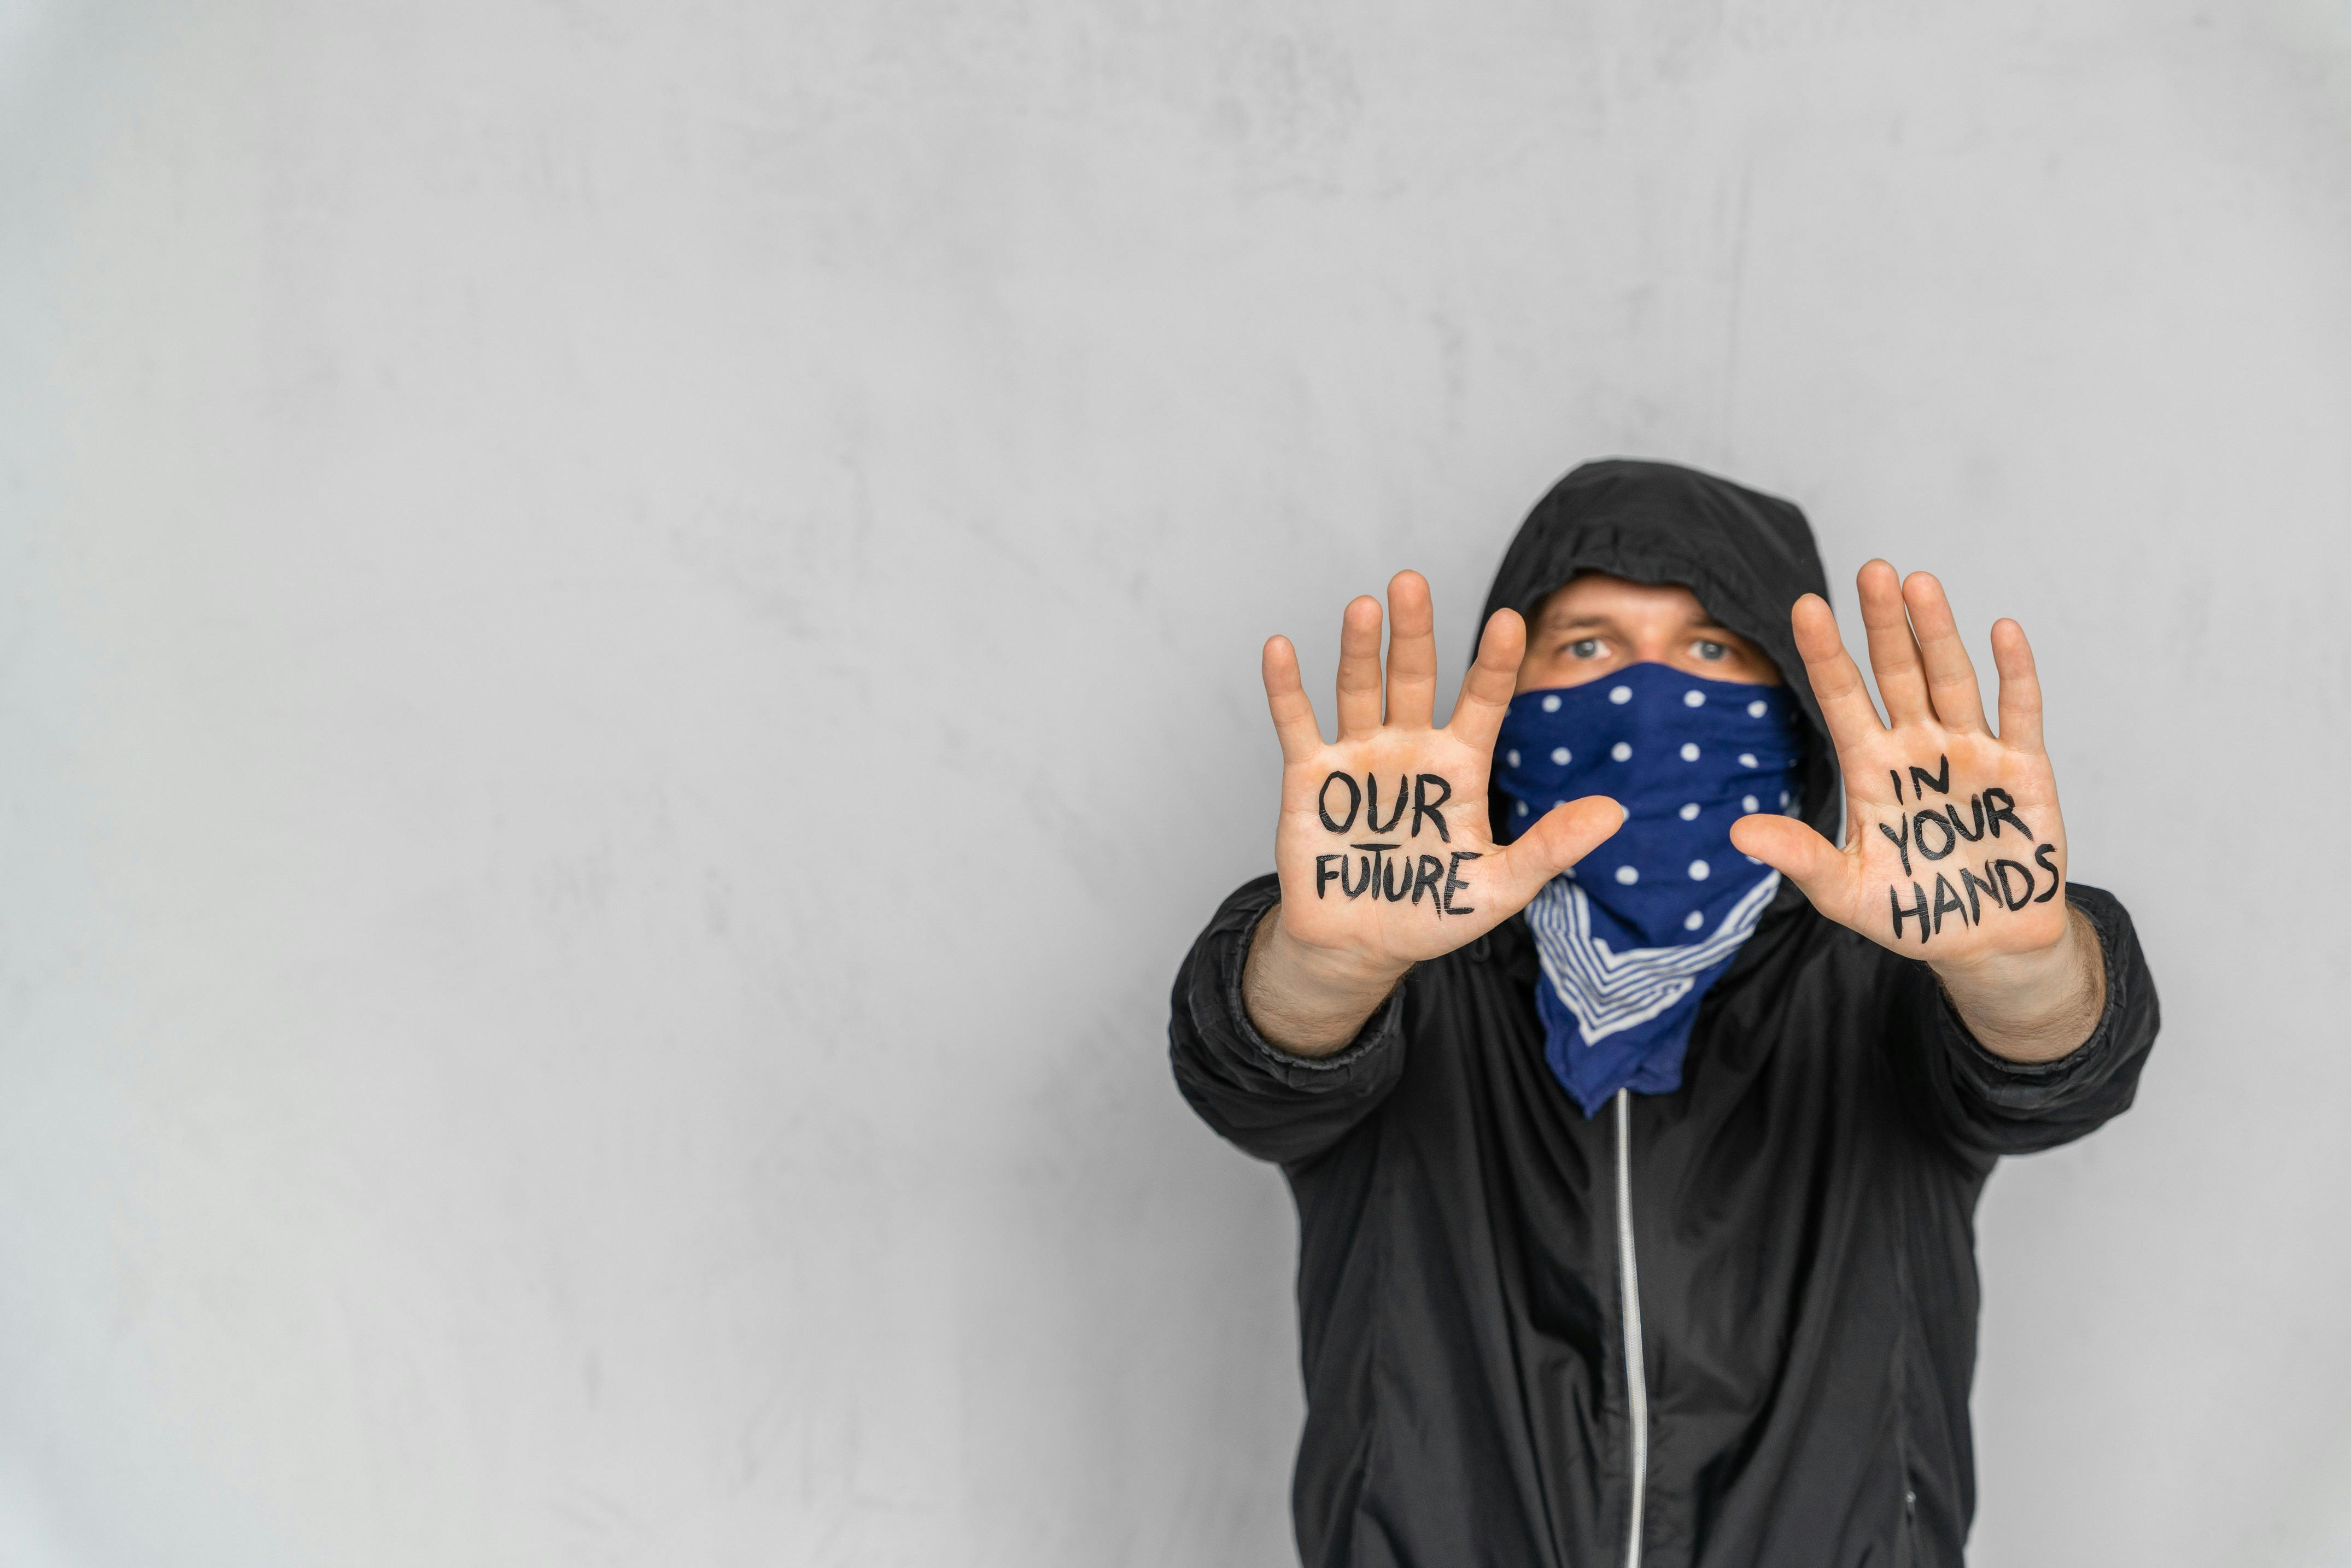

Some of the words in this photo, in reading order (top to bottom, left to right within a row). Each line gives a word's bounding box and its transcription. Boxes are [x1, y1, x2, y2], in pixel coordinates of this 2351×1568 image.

[1318, 770, 1452, 844] OUR
[1890, 753, 1950, 806] IN
[1878, 787, 2034, 877] YOUR
[1316, 843, 1484, 921] FUTURE
[1890, 843, 2060, 945] HANDS
